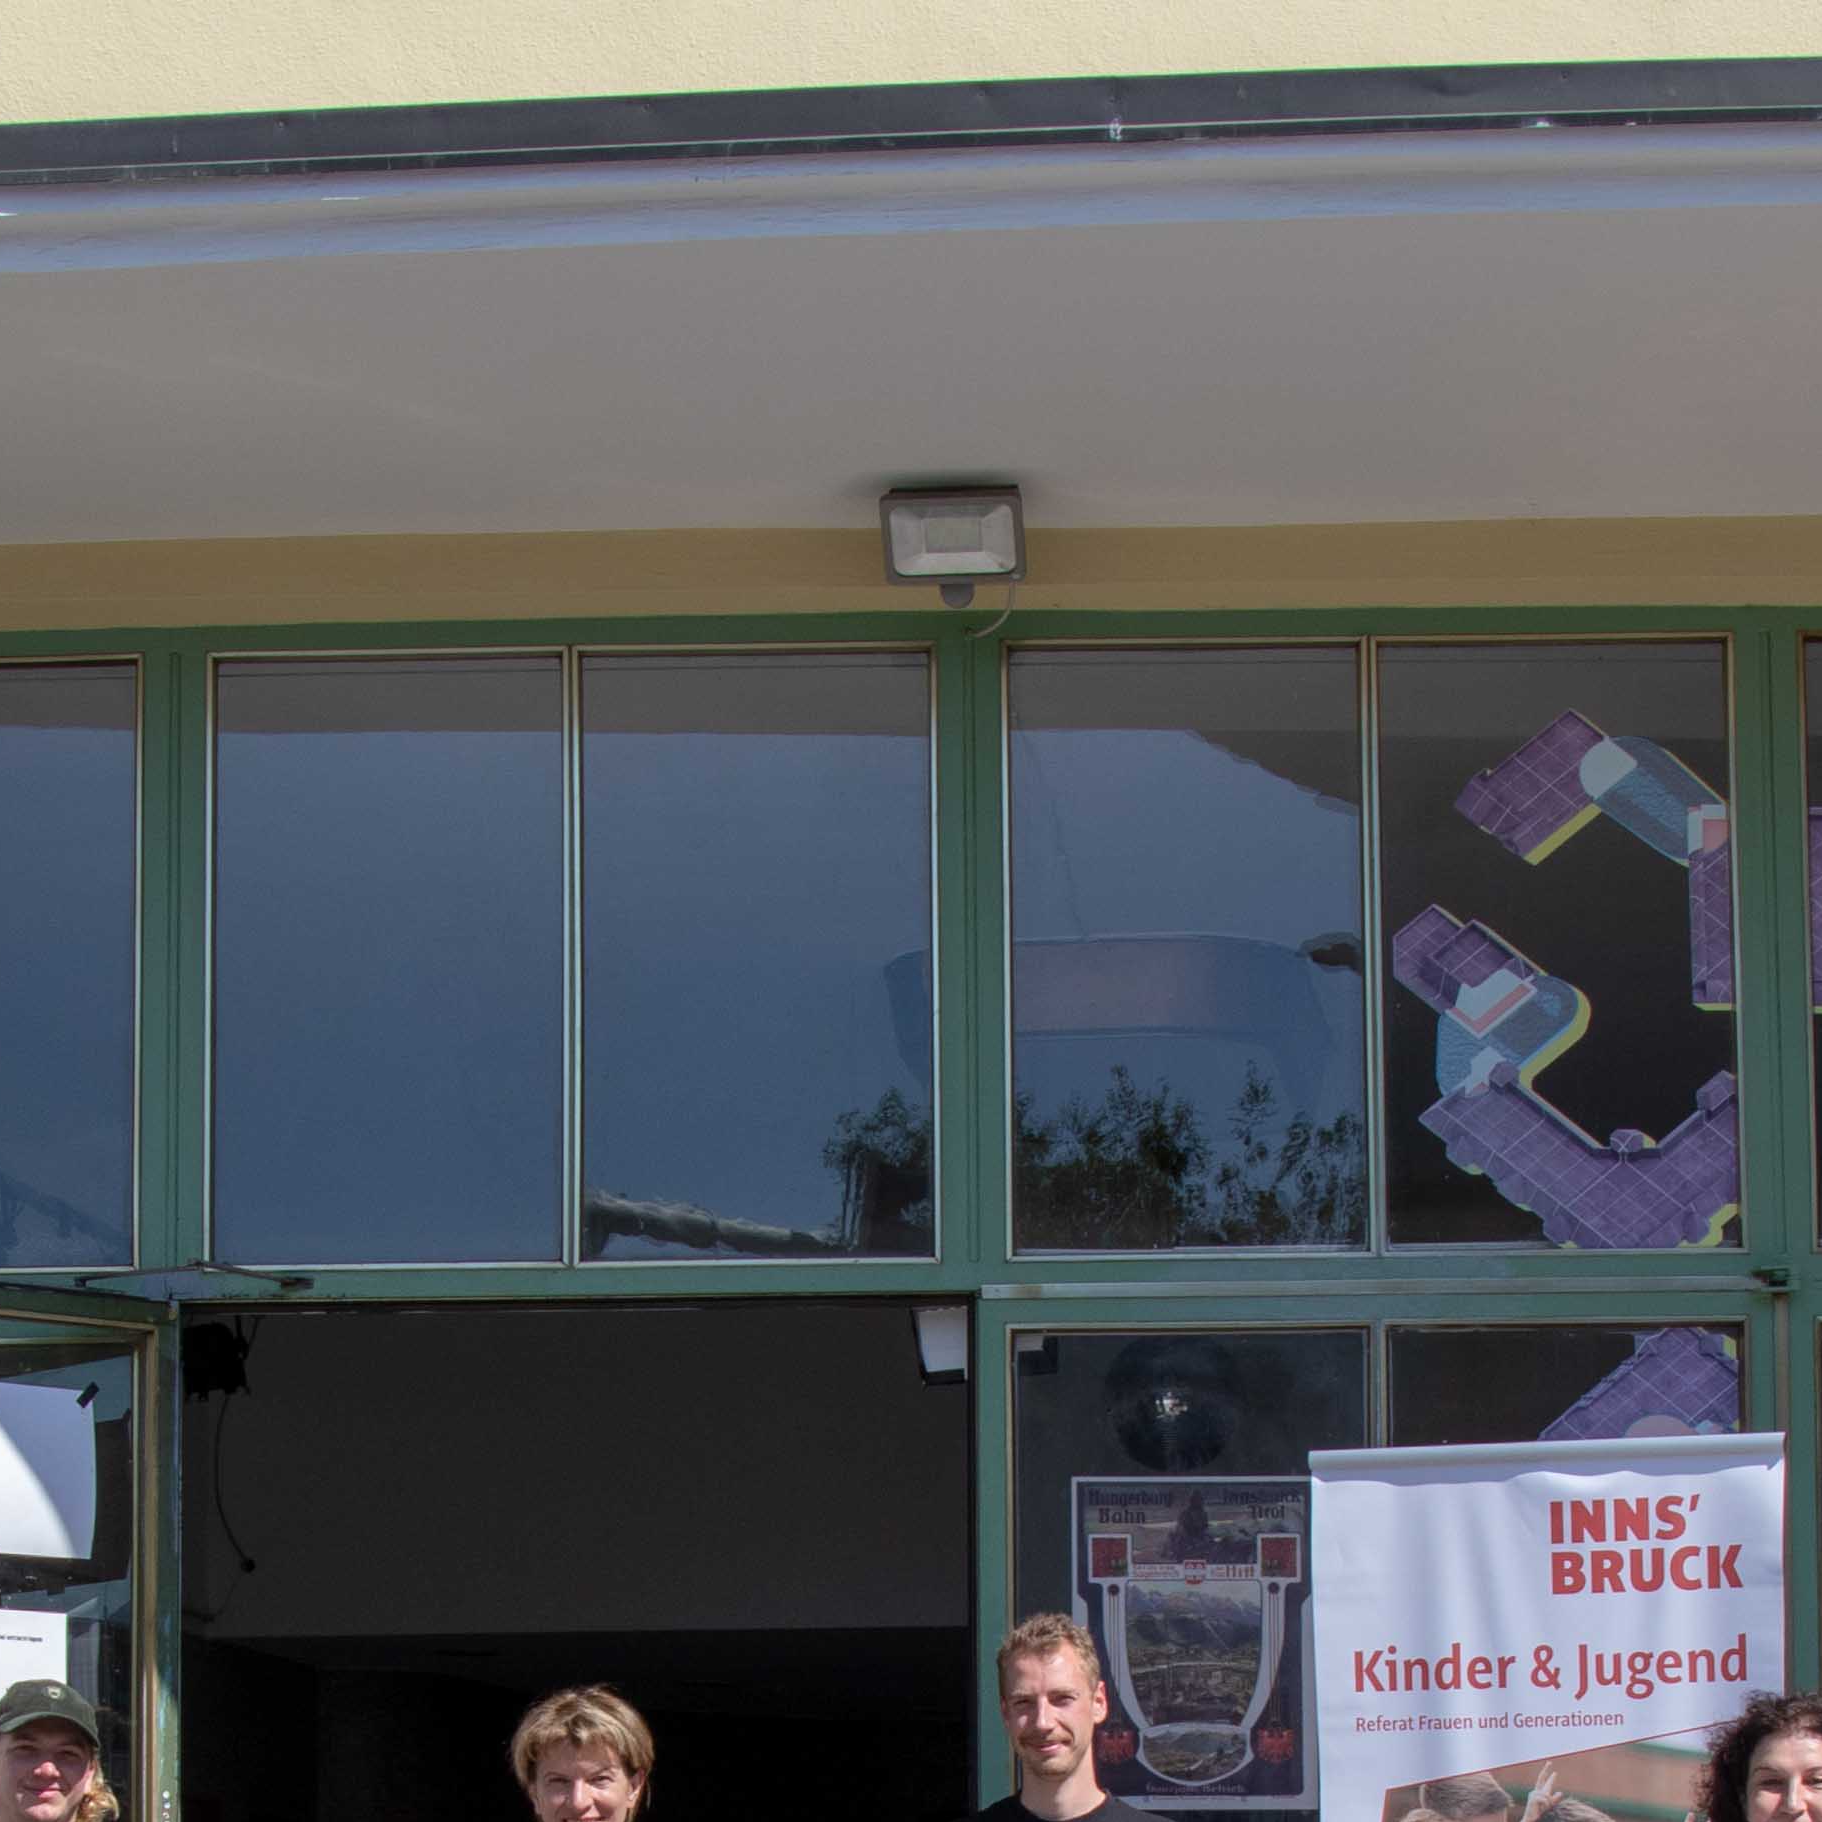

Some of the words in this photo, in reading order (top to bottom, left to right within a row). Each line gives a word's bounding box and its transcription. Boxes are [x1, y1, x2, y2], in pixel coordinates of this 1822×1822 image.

[1550, 1544, 1743, 1596] BRUCK
[1353, 1641, 1516, 1693] Kinder
[1530, 1643, 1561, 1690] &
[1574, 1633, 1747, 1700] Jugend
[1355, 1714, 1415, 1733] Referat
[1418, 1714, 1473, 1731] Frauen
[1478, 1711, 1509, 1730] und
[1513, 1709, 1625, 1729] Generationen
